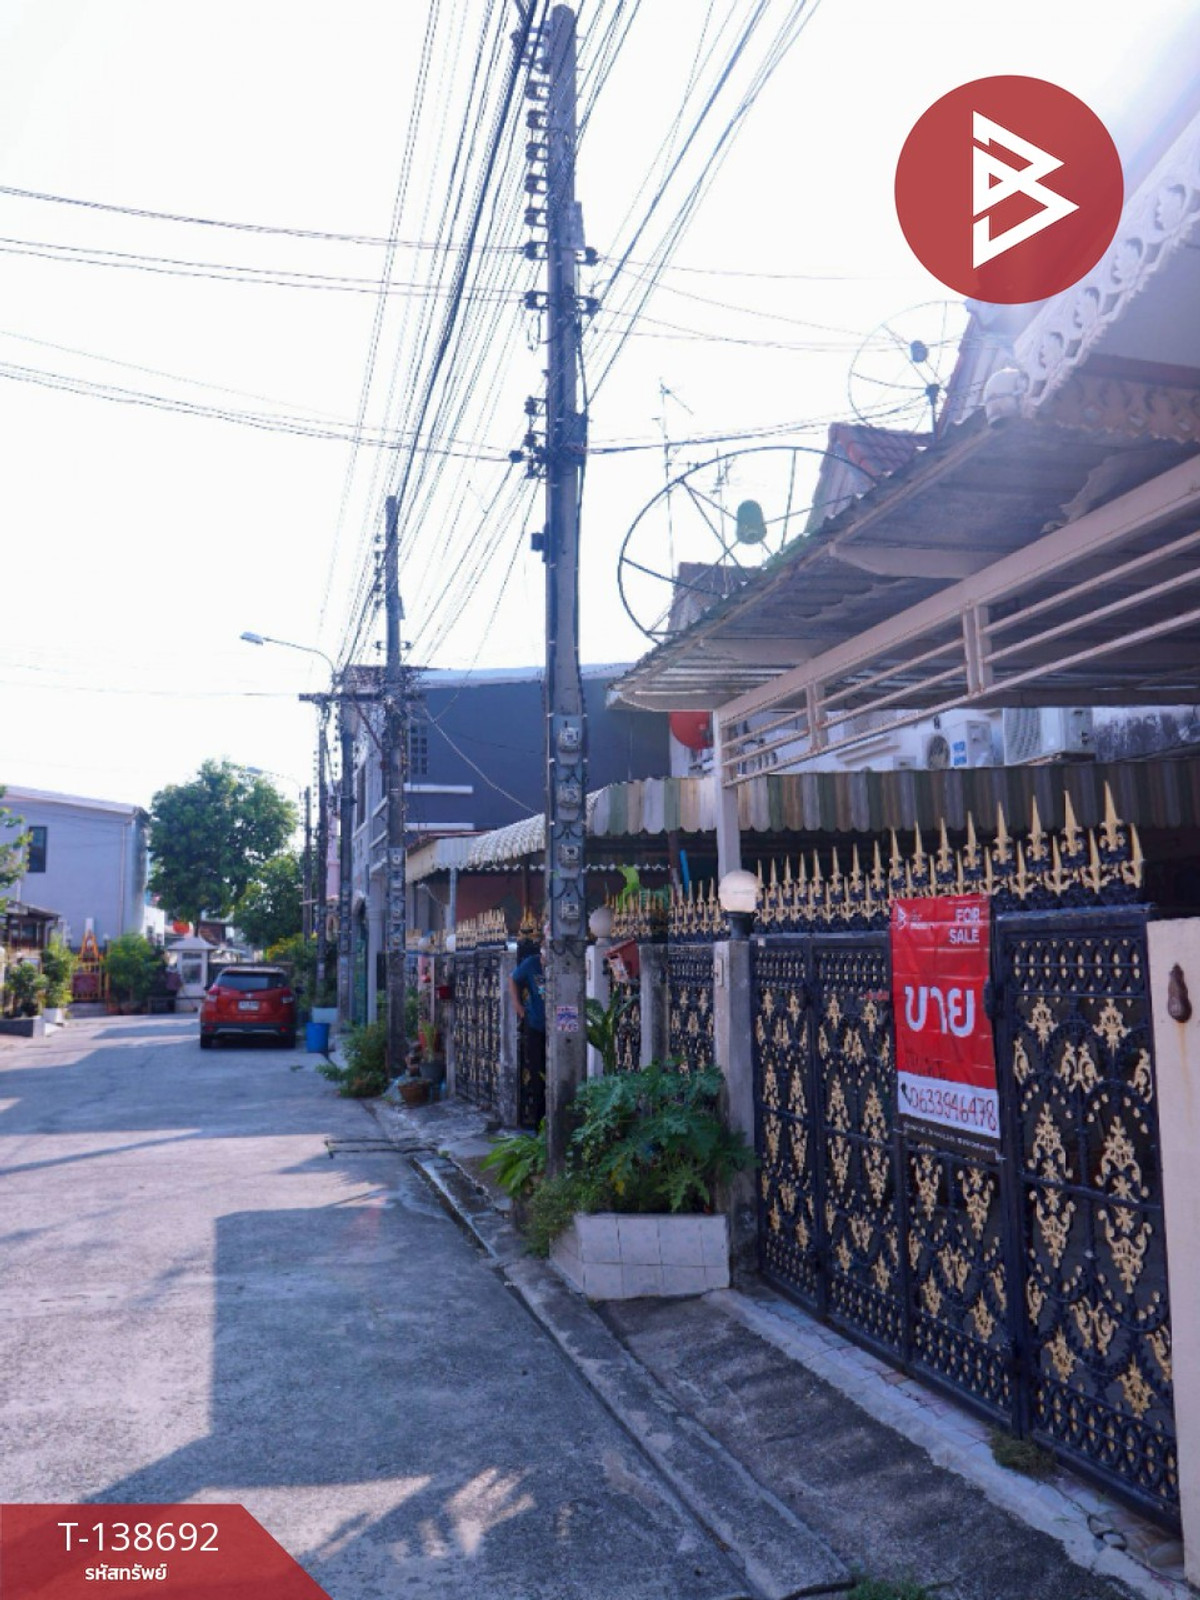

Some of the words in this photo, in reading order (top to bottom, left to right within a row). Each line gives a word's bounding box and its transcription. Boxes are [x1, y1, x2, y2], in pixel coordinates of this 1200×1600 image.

[955, 907, 980, 923] FOR
[949, 927, 980, 944] SALE
[904, 985, 976, 1038] ขาย
